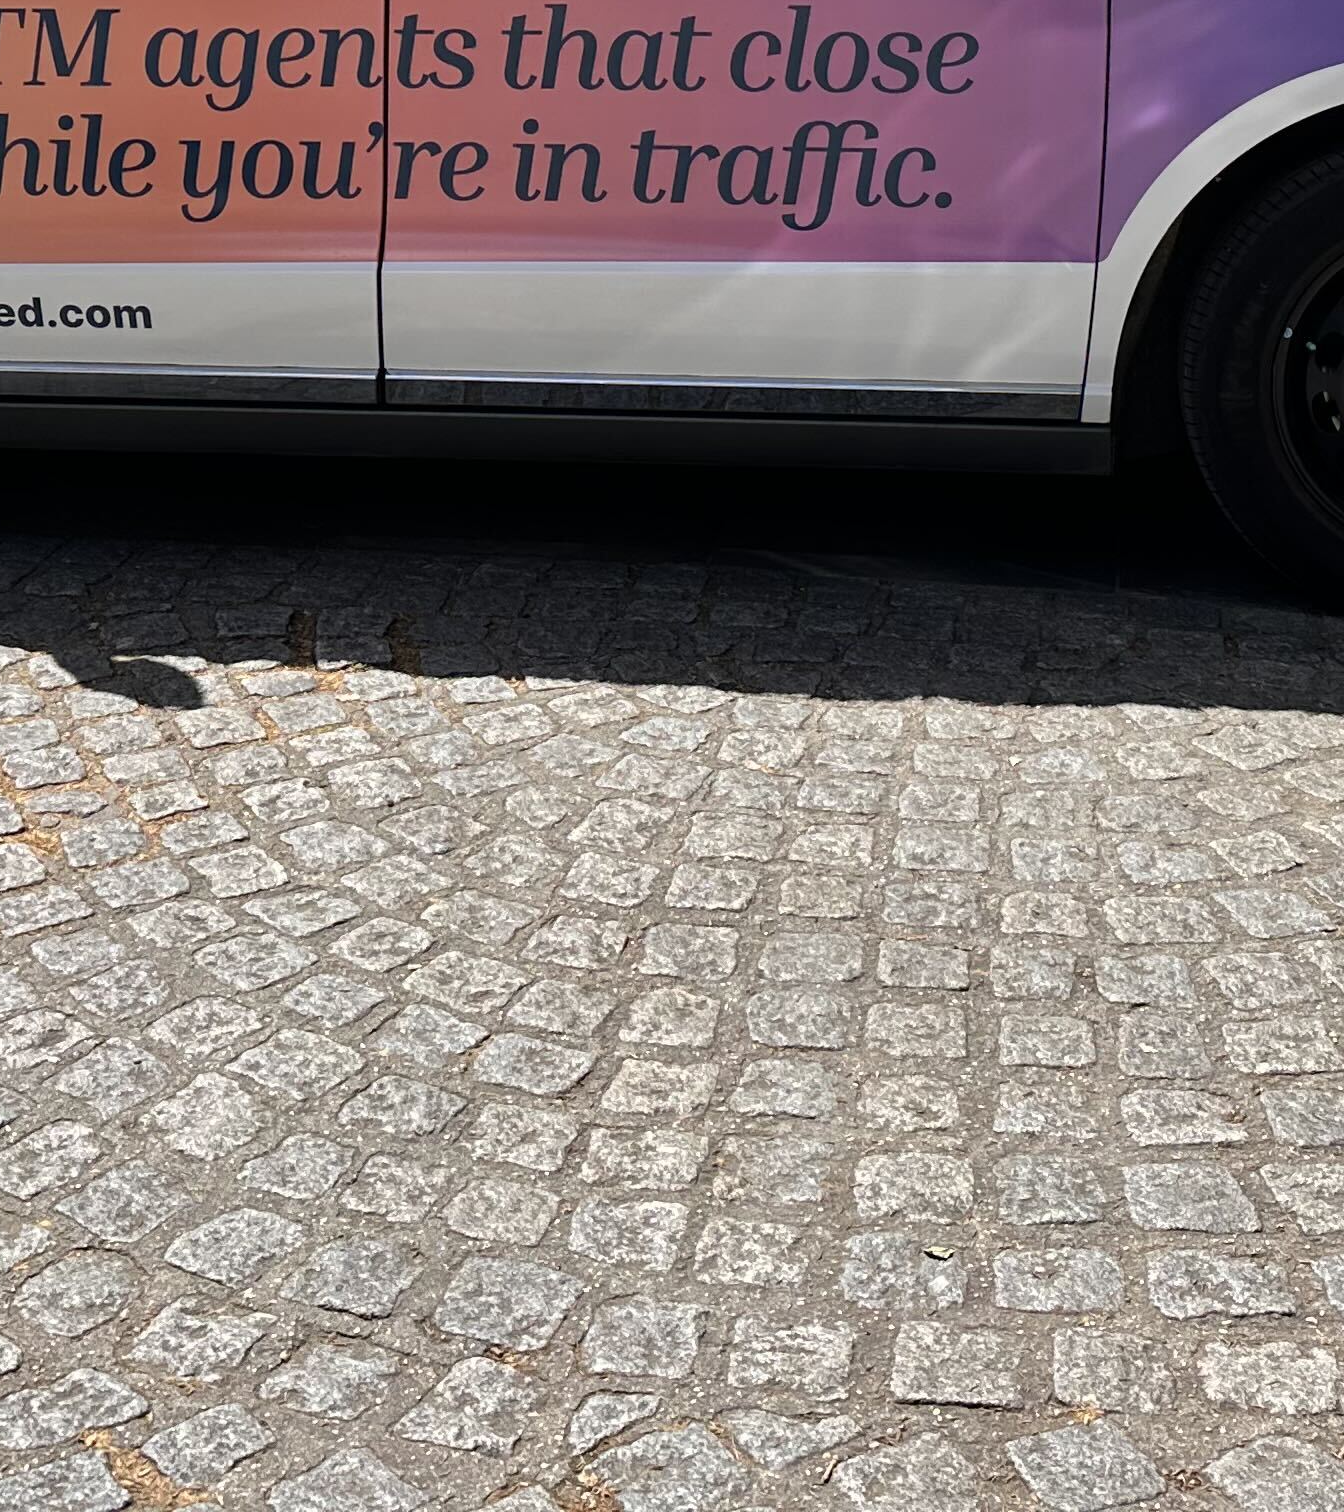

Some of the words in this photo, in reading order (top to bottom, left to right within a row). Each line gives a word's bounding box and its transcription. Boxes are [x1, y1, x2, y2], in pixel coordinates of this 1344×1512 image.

[144, 13, 478, 112] agents
[501, 3, 713, 92] that
[730, 5, 980, 95] close
[178, 121, 490, 223] you’re
[512, 118, 608, 203] in
[630, 120, 953, 231] traffic.
